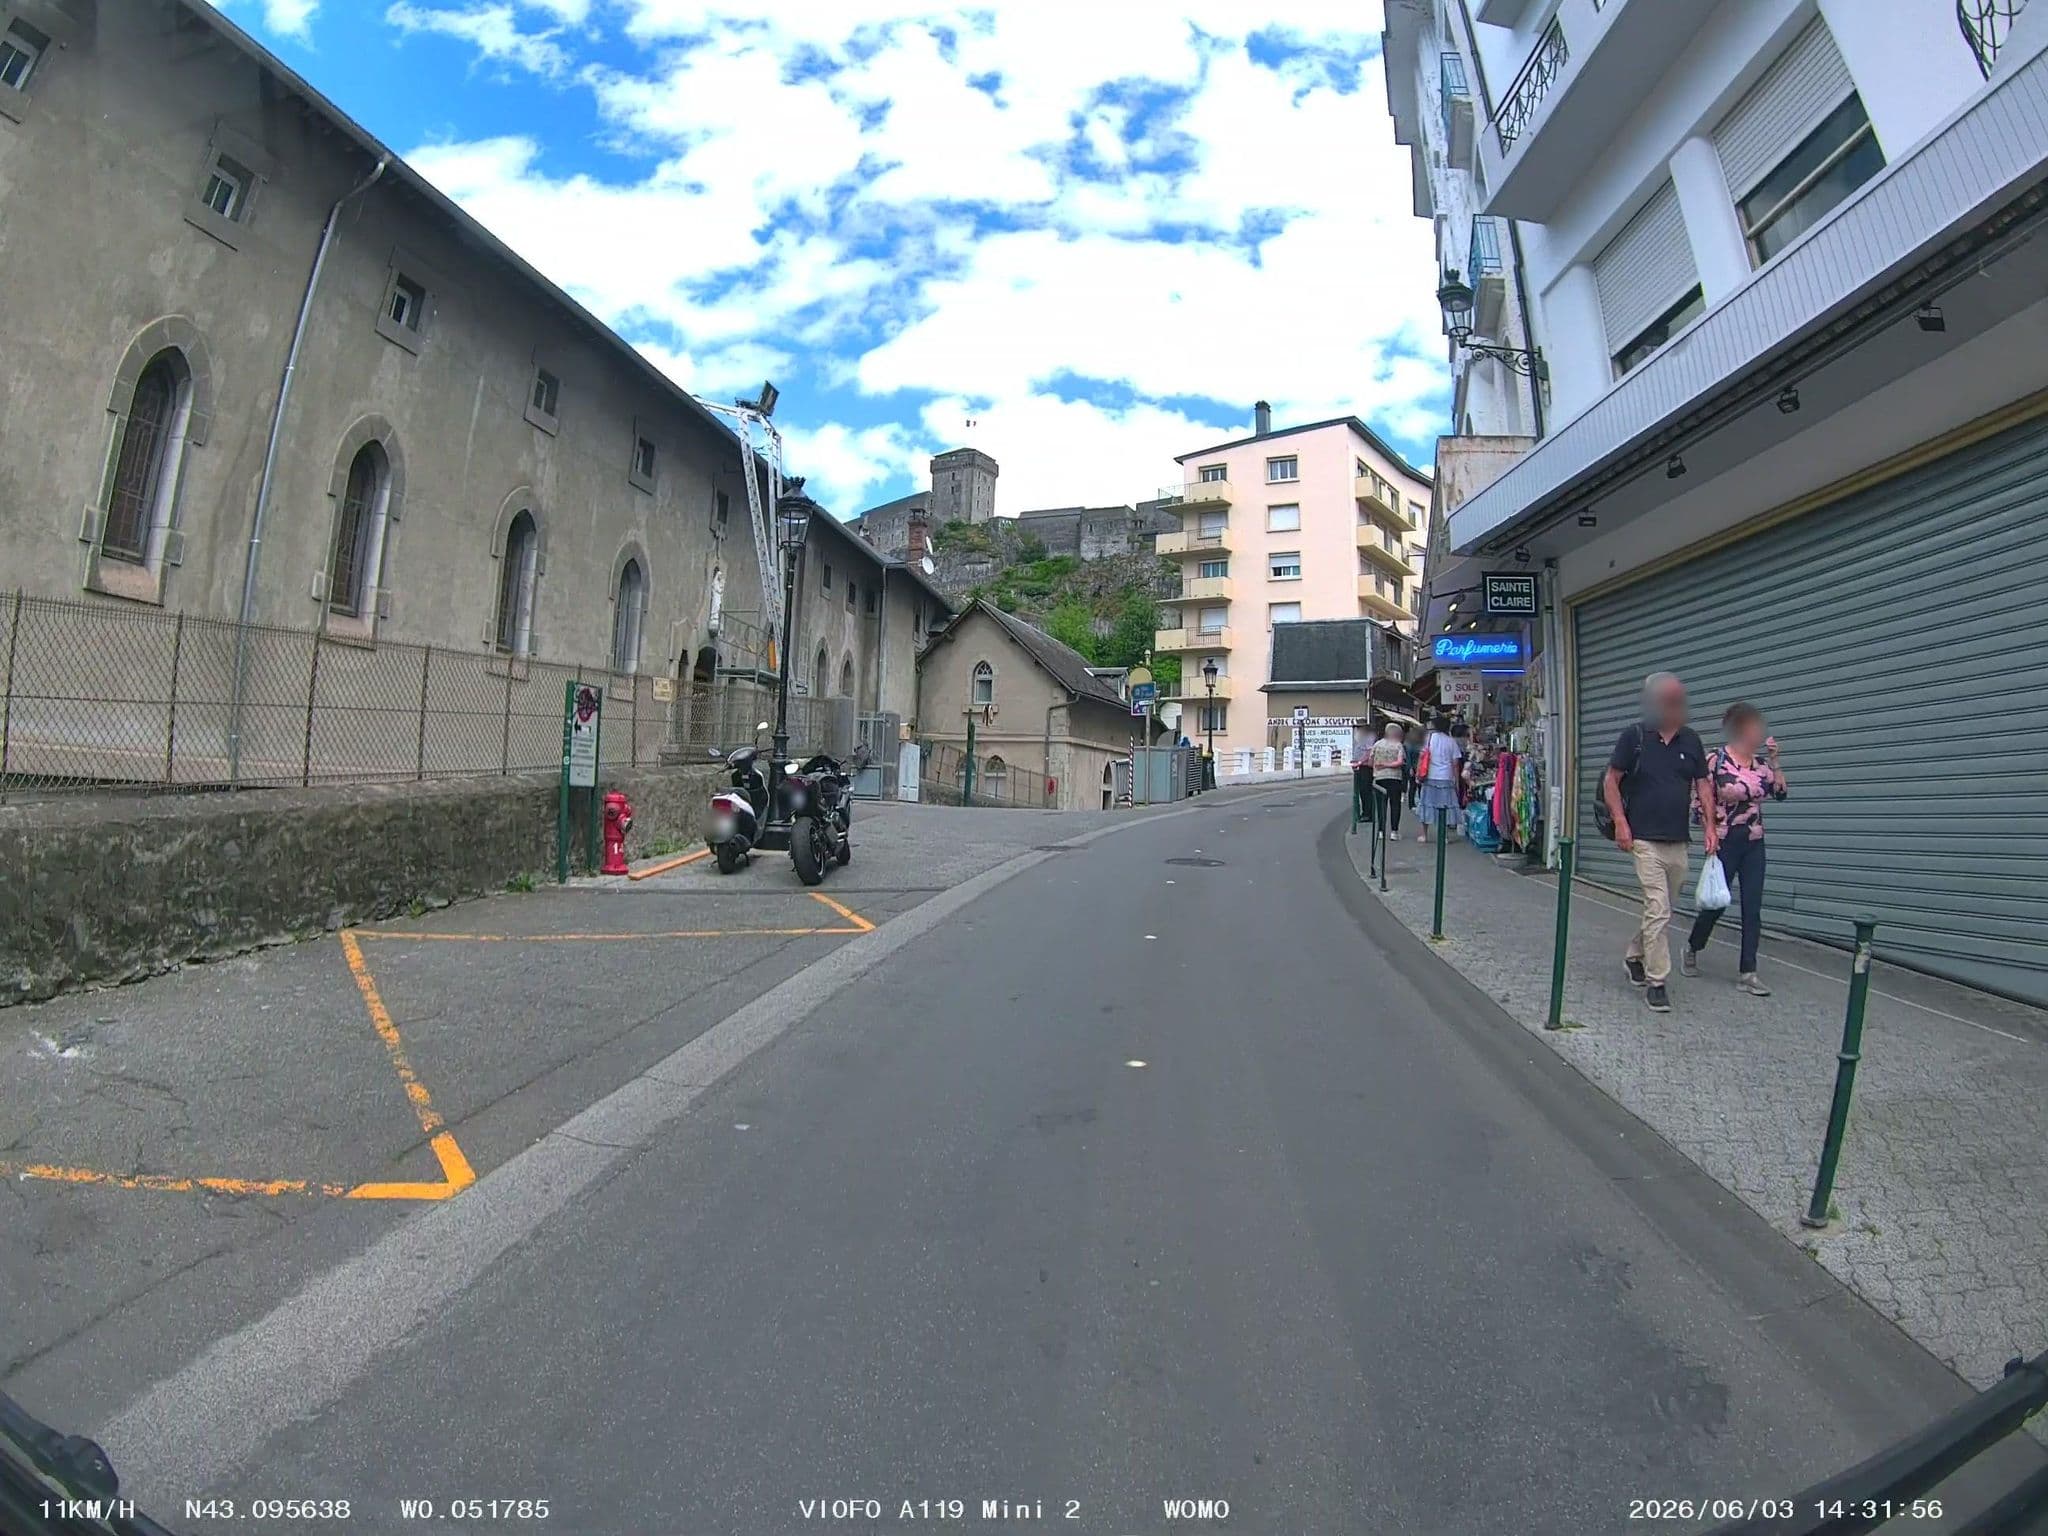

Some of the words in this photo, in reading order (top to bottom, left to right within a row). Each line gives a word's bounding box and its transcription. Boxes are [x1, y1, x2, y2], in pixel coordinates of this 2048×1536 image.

[1490, 581, 1531, 593] SAINTE
[1490, 596, 1532, 607] CLAIRE
[1435, 638, 1518, 661] Parfumerie
[1455, 683, 1480, 692] SOLE
[1453, 693, 1472, 702] MIO
